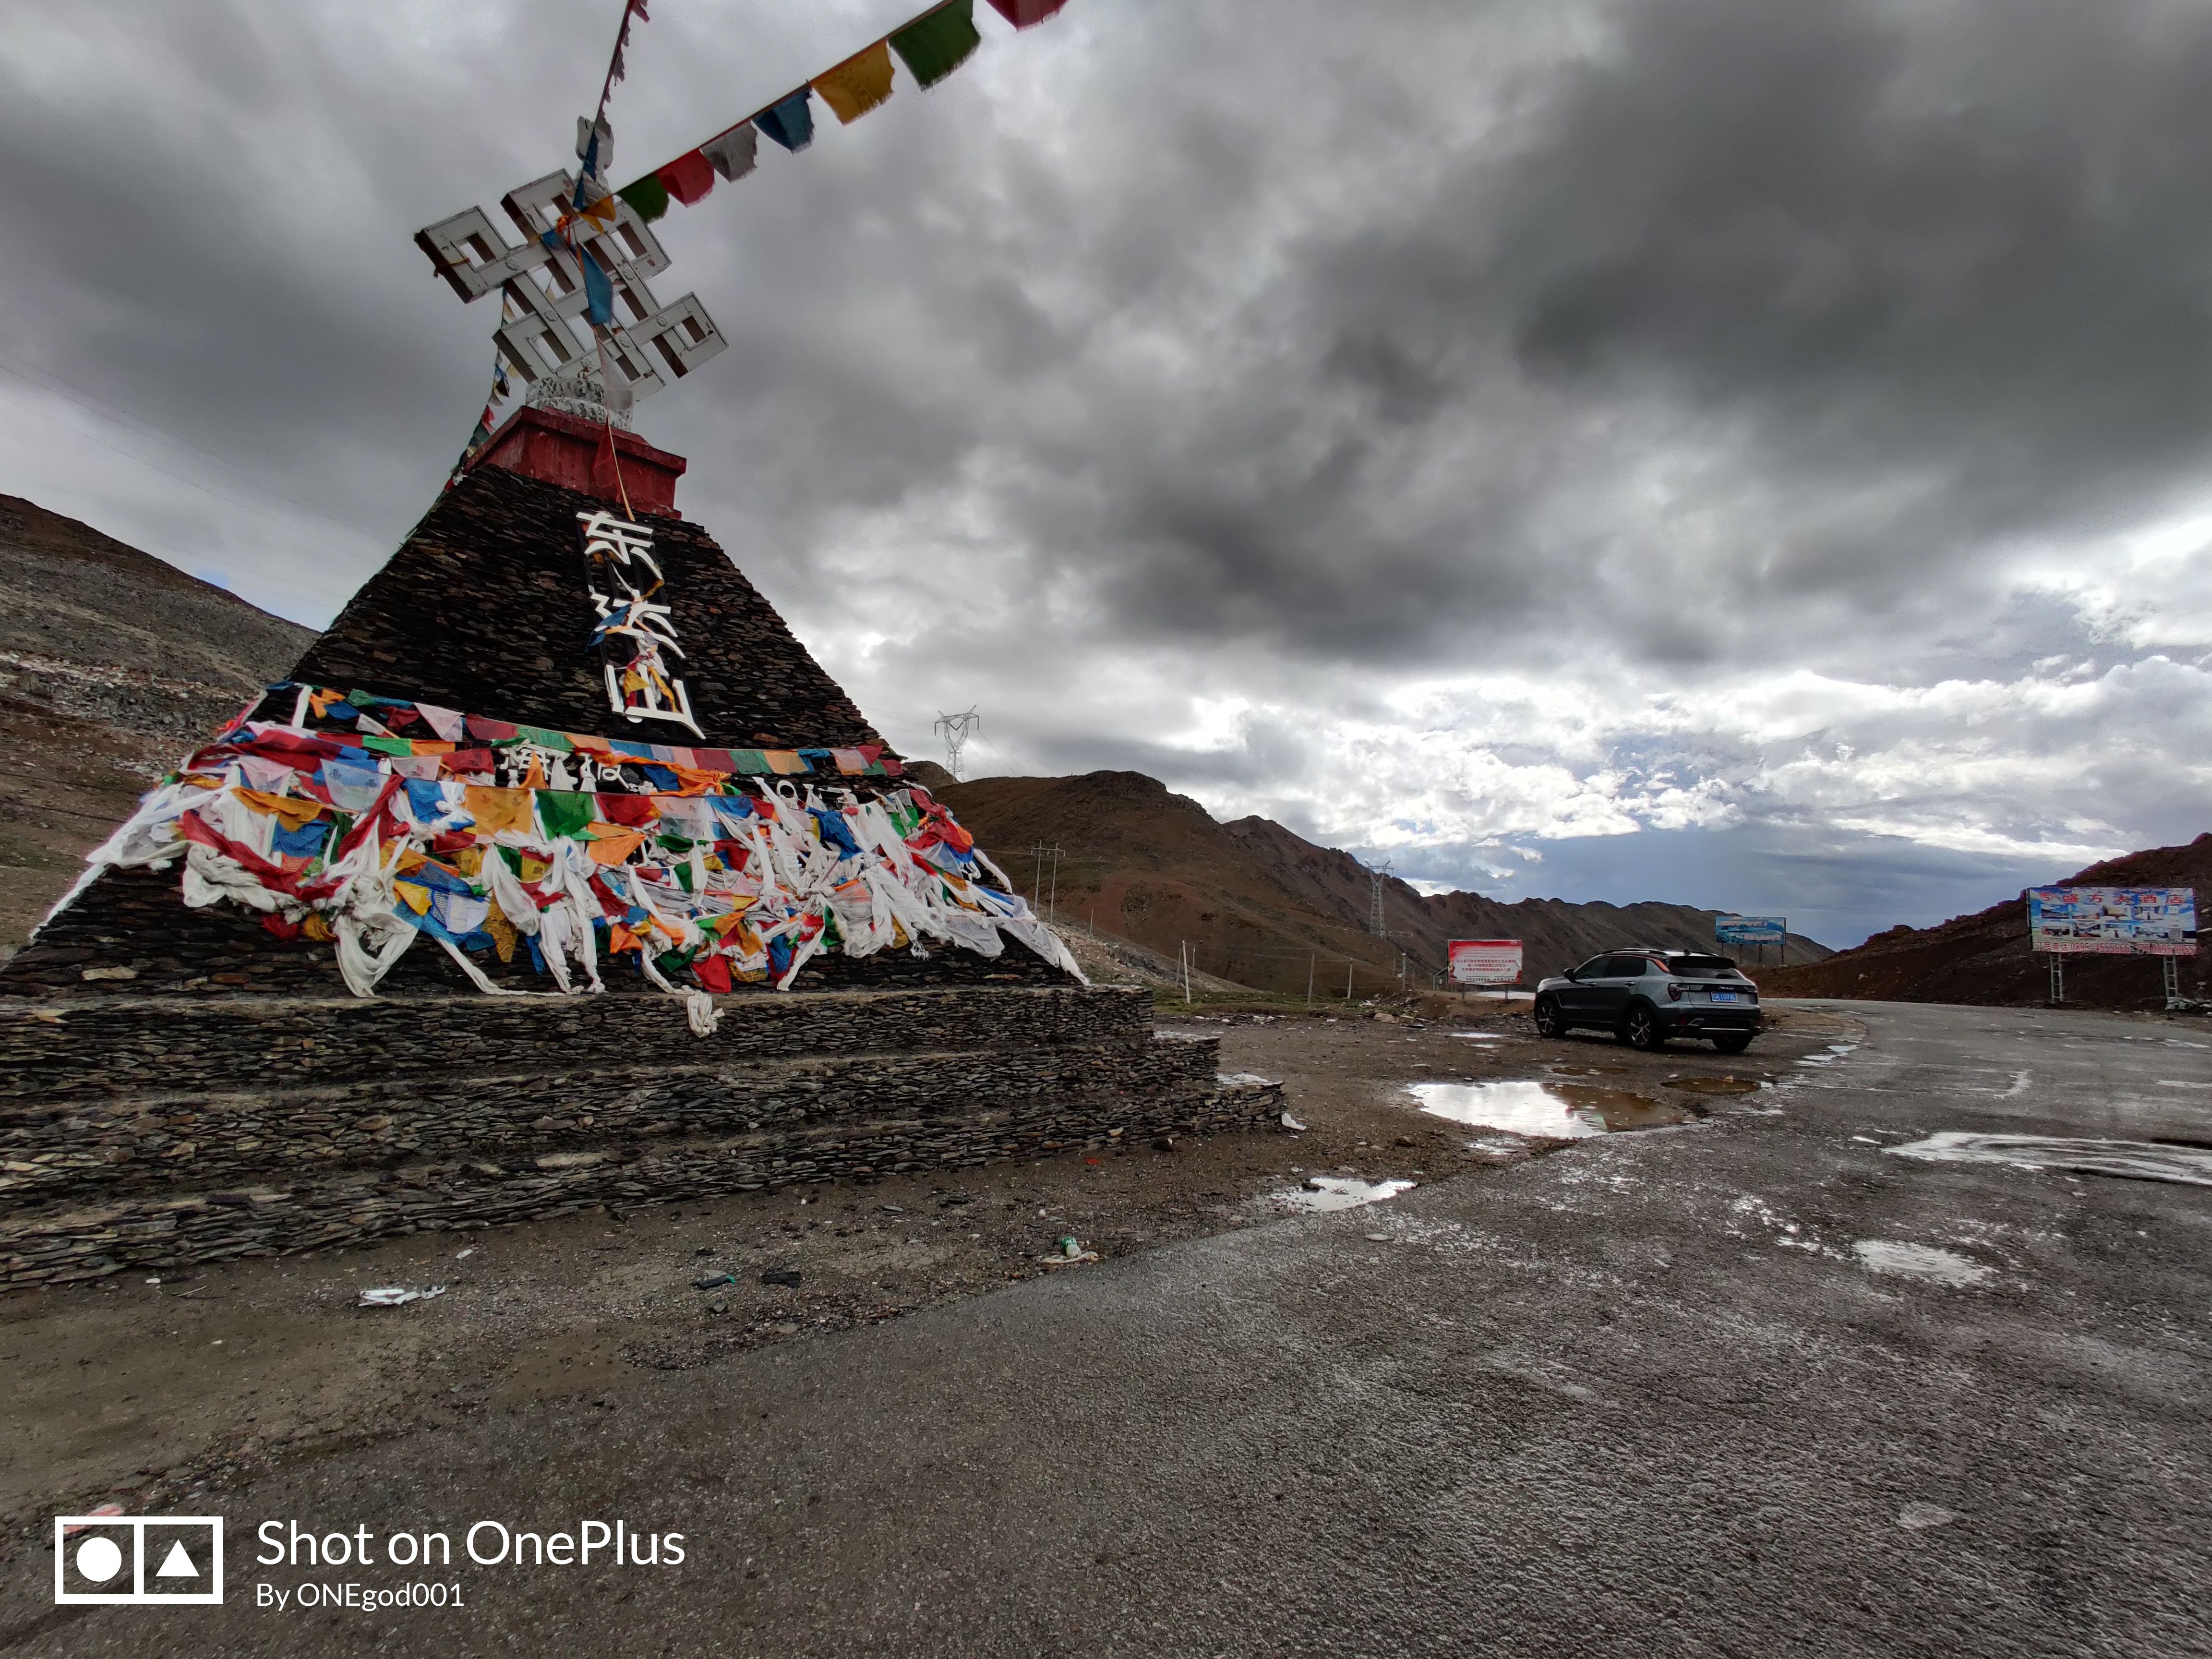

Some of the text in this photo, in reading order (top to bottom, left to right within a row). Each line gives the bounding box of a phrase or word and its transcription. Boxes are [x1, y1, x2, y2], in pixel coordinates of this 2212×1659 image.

[2062, 893, 2185, 905] 盛方大酒店
